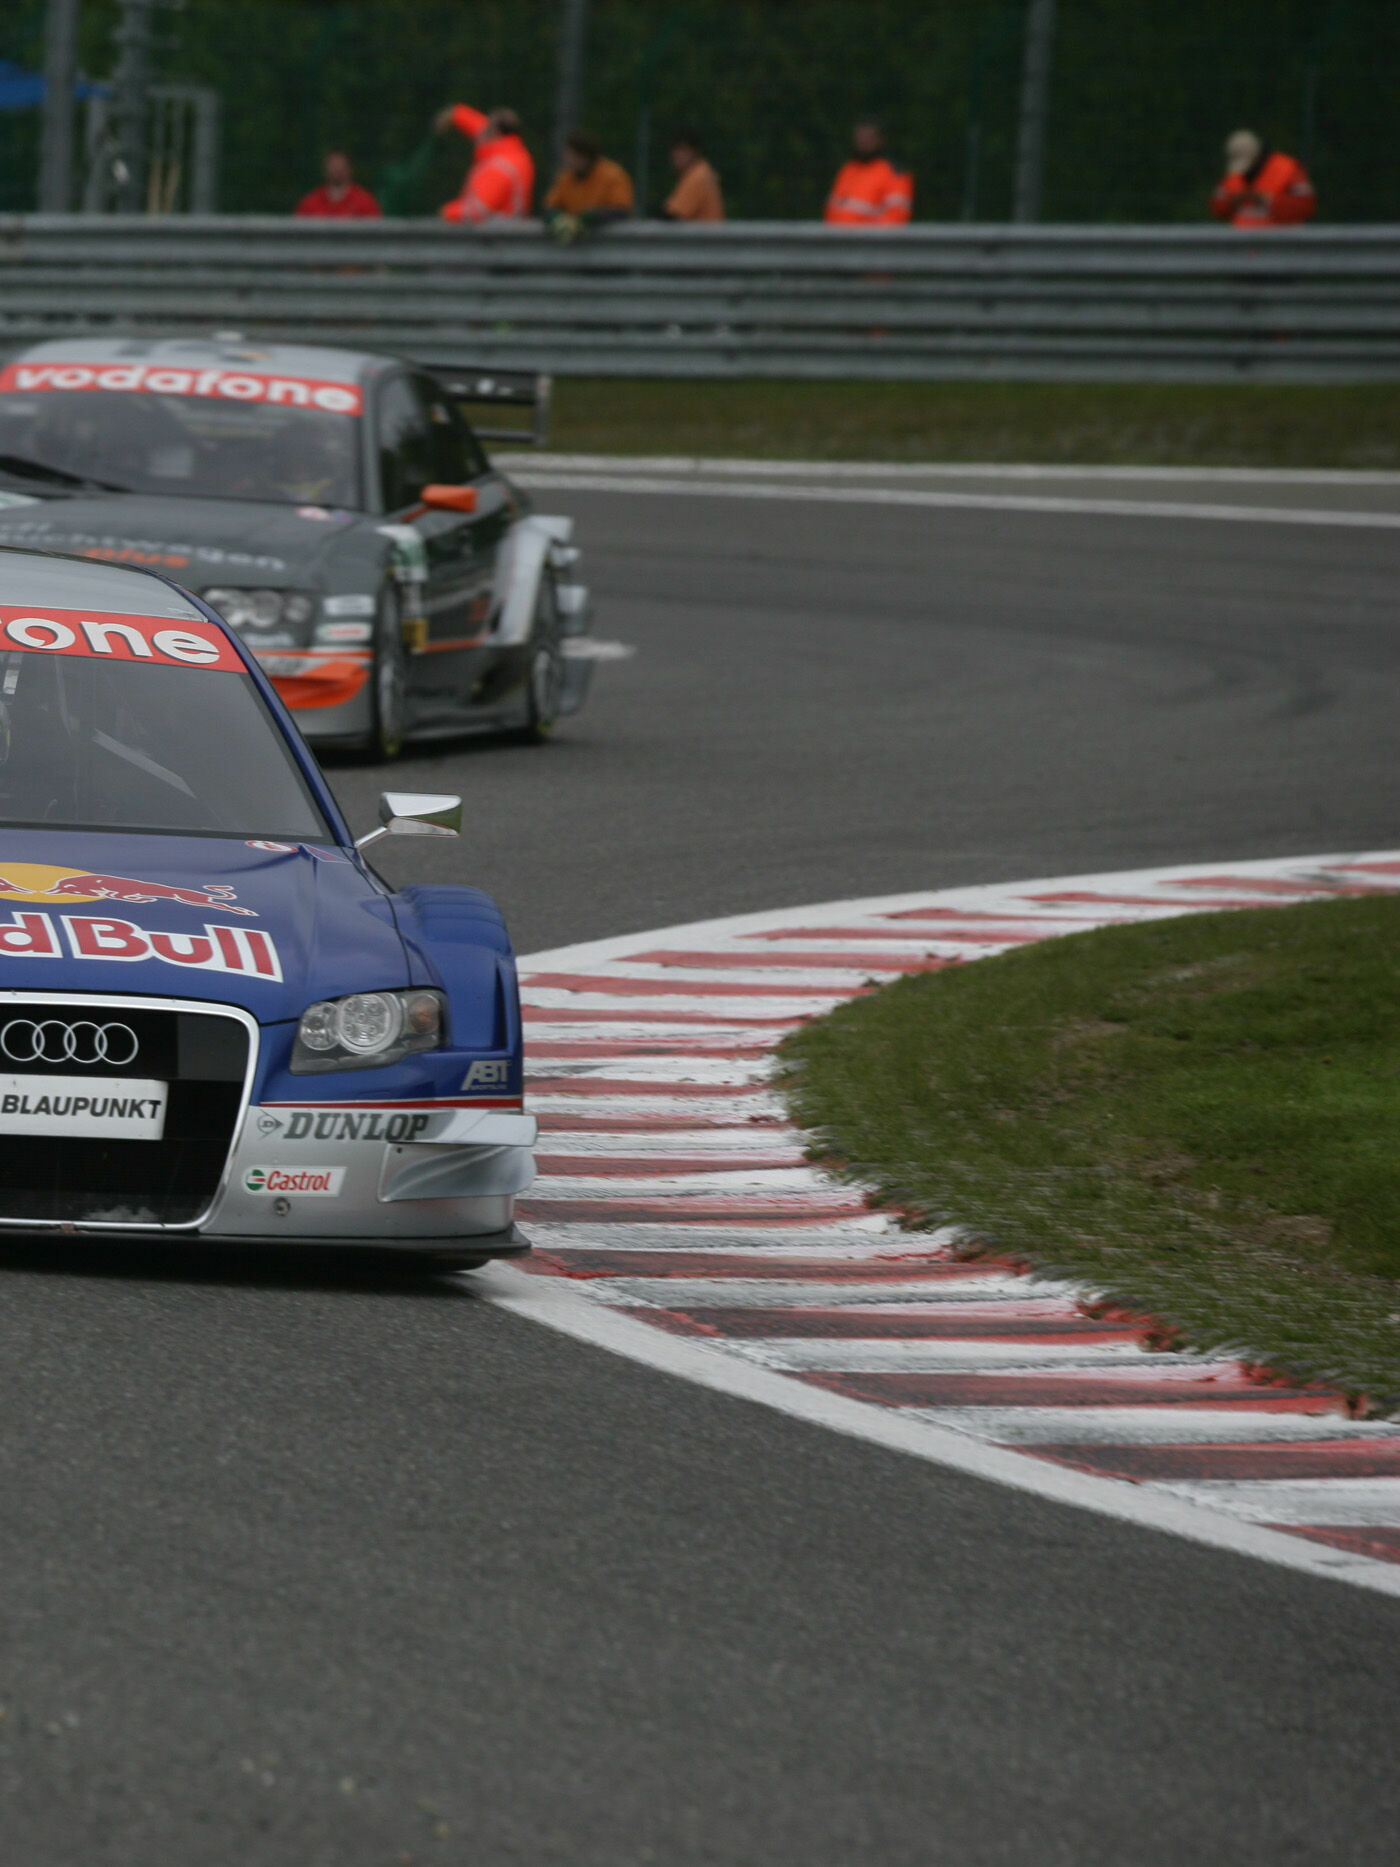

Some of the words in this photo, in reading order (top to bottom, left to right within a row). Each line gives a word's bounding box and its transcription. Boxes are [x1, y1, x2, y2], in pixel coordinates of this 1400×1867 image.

[14, 365, 360, 412] vodafone
[61, 915, 284, 983] Bull
[461, 1060, 508, 1090] ABT
[1, 1094, 161, 1119] BLAUPUNKT
[283, 1112, 429, 1142] DUNLOP
[266, 1170, 331, 1192] Castrol
